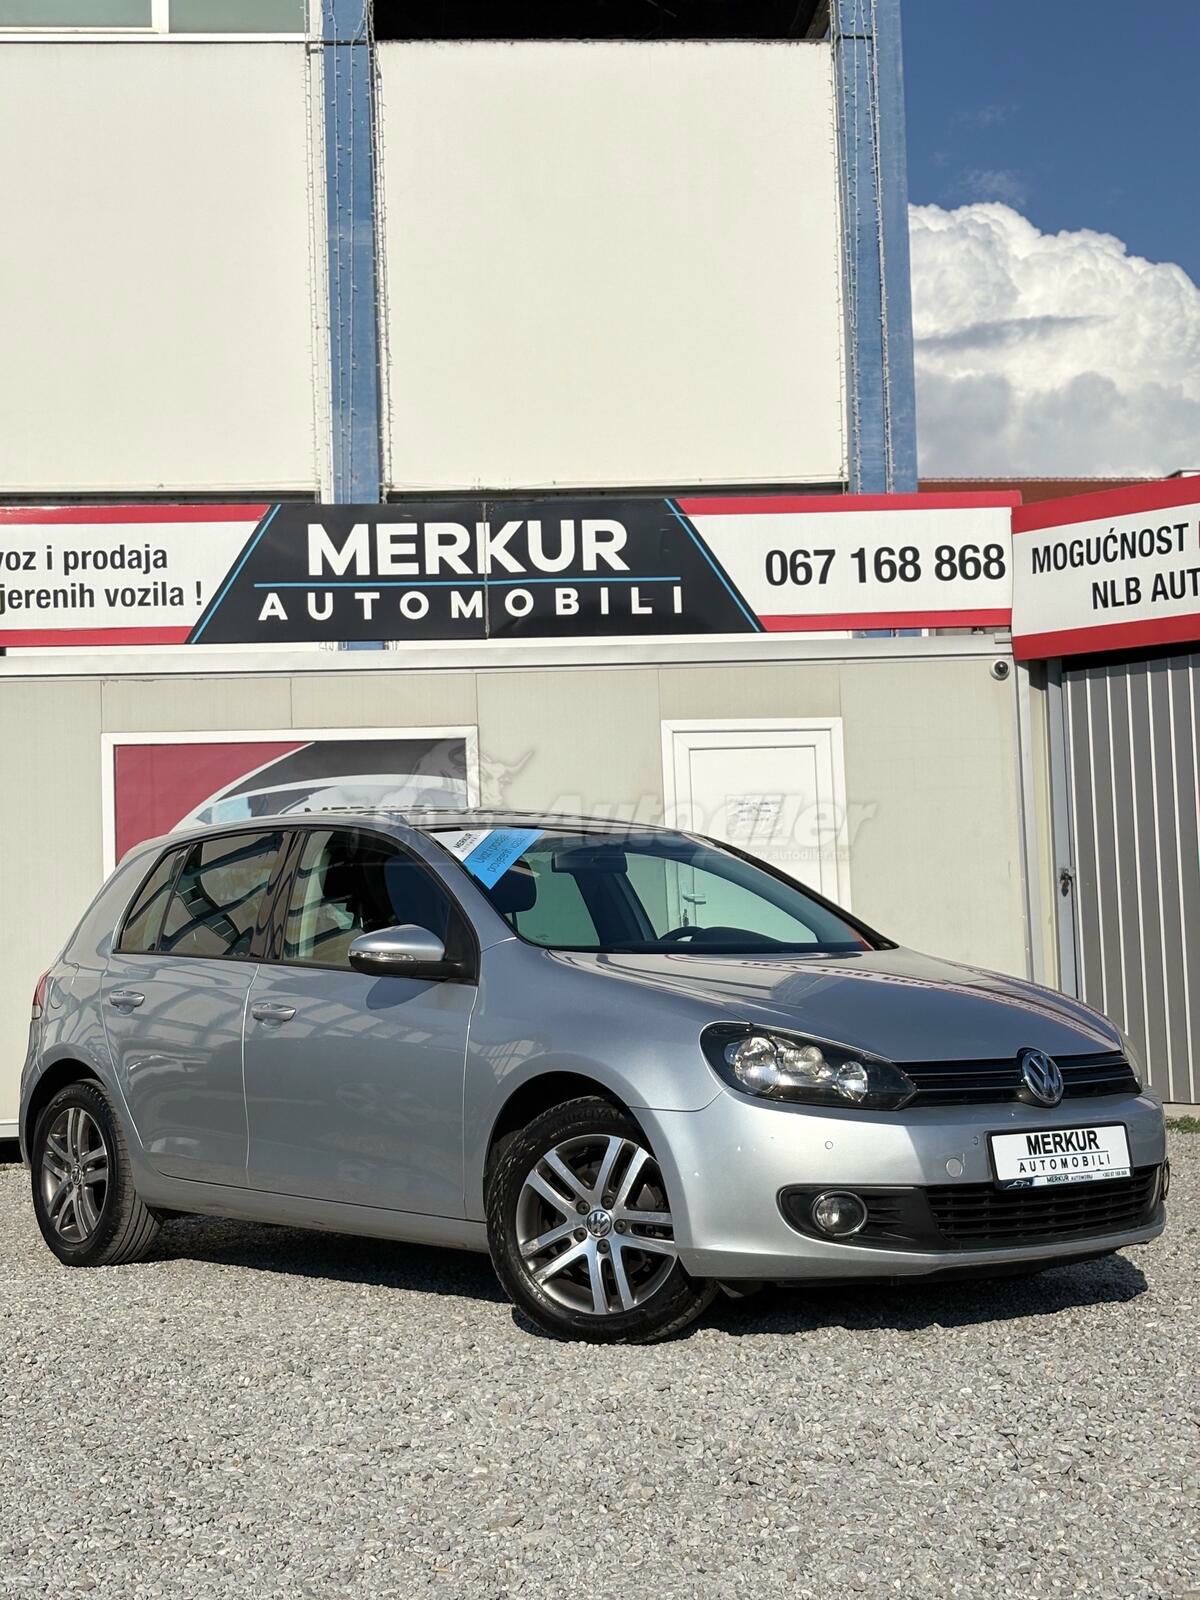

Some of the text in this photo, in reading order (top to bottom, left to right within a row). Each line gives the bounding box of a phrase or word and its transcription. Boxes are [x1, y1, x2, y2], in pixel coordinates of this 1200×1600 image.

[0, 544, 168, 576] oz i prodaja
[307, 518, 628, 576] MERKUR
[1032, 523, 1189, 574] MOGUĆNOST
[765, 544, 1007, 586] 067 168 868
[104, 581, 184, 607] vozila
[257, 586, 683, 622] AUTOMOBILI
[1092, 576, 1142, 610] NLB
[1026, 1130, 1100, 1156] MERKUR
[1019, 1154, 1111, 1173] AUTOMOBILI
